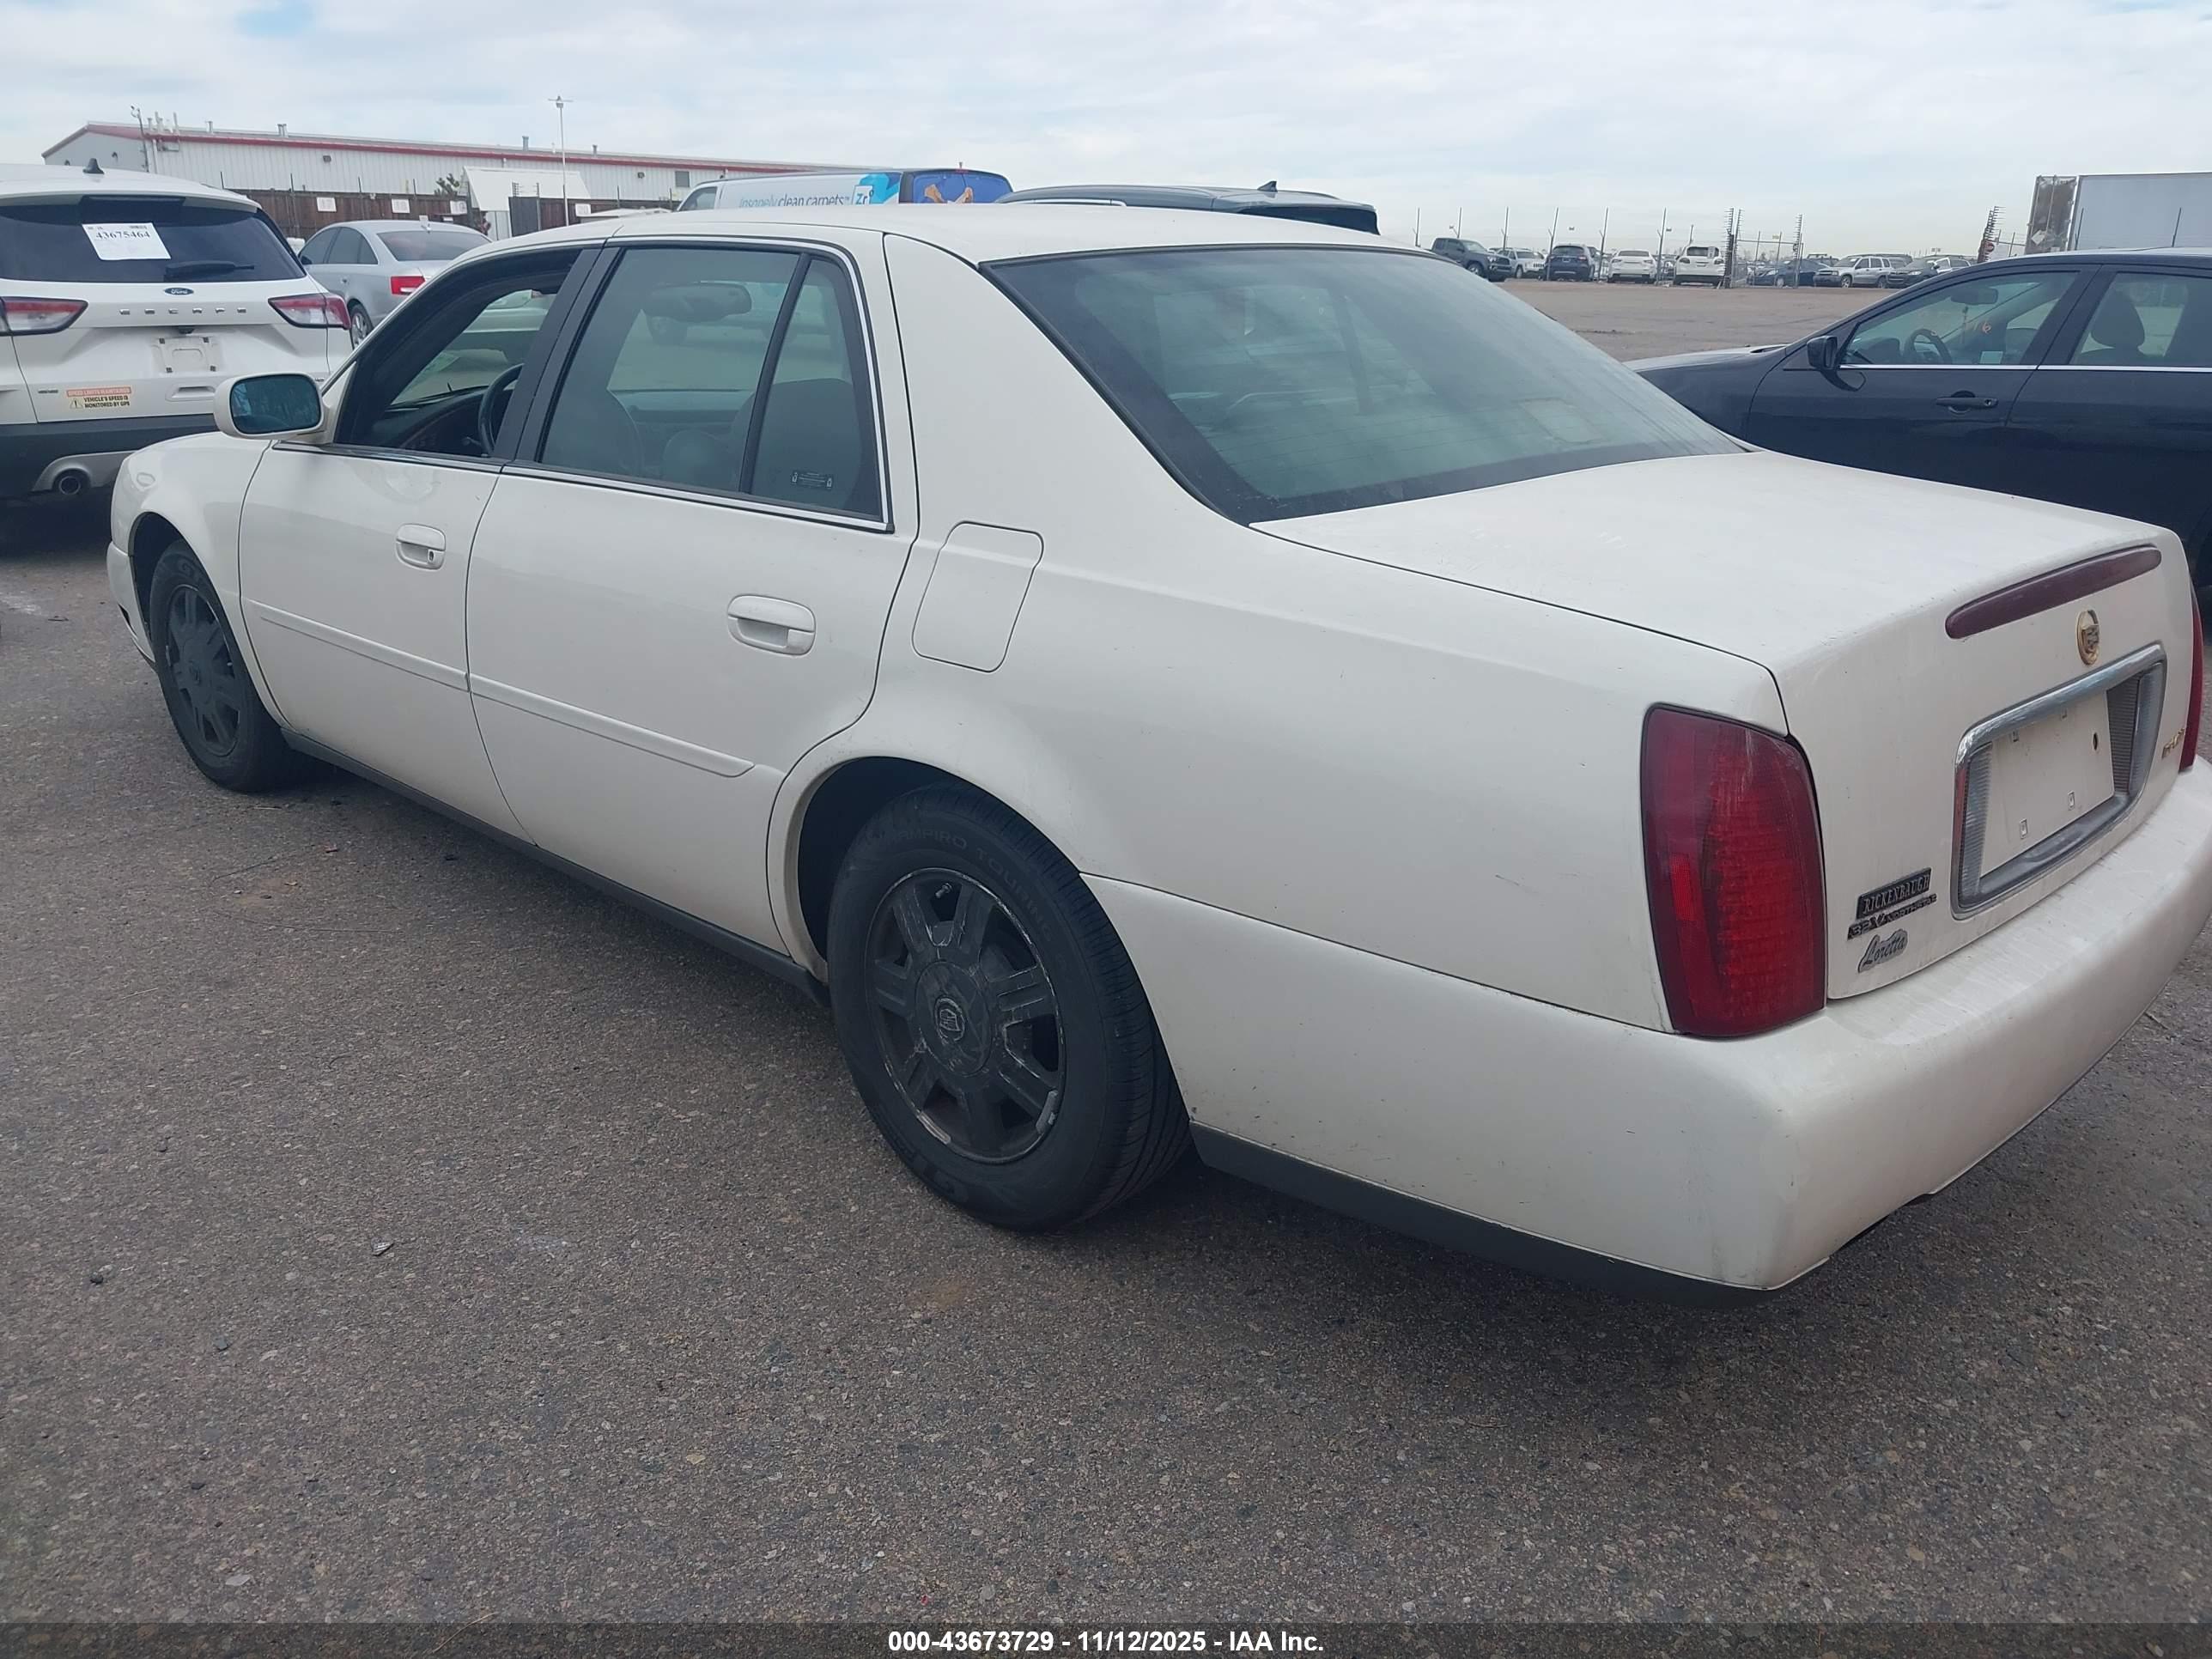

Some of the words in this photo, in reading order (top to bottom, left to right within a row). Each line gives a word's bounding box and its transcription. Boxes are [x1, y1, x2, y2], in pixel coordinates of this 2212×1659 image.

[777, 194, 804, 207] clean
[95, 230, 150, 240] 43675464
[1863, 874, 1930, 914] RICKENBAUGH
